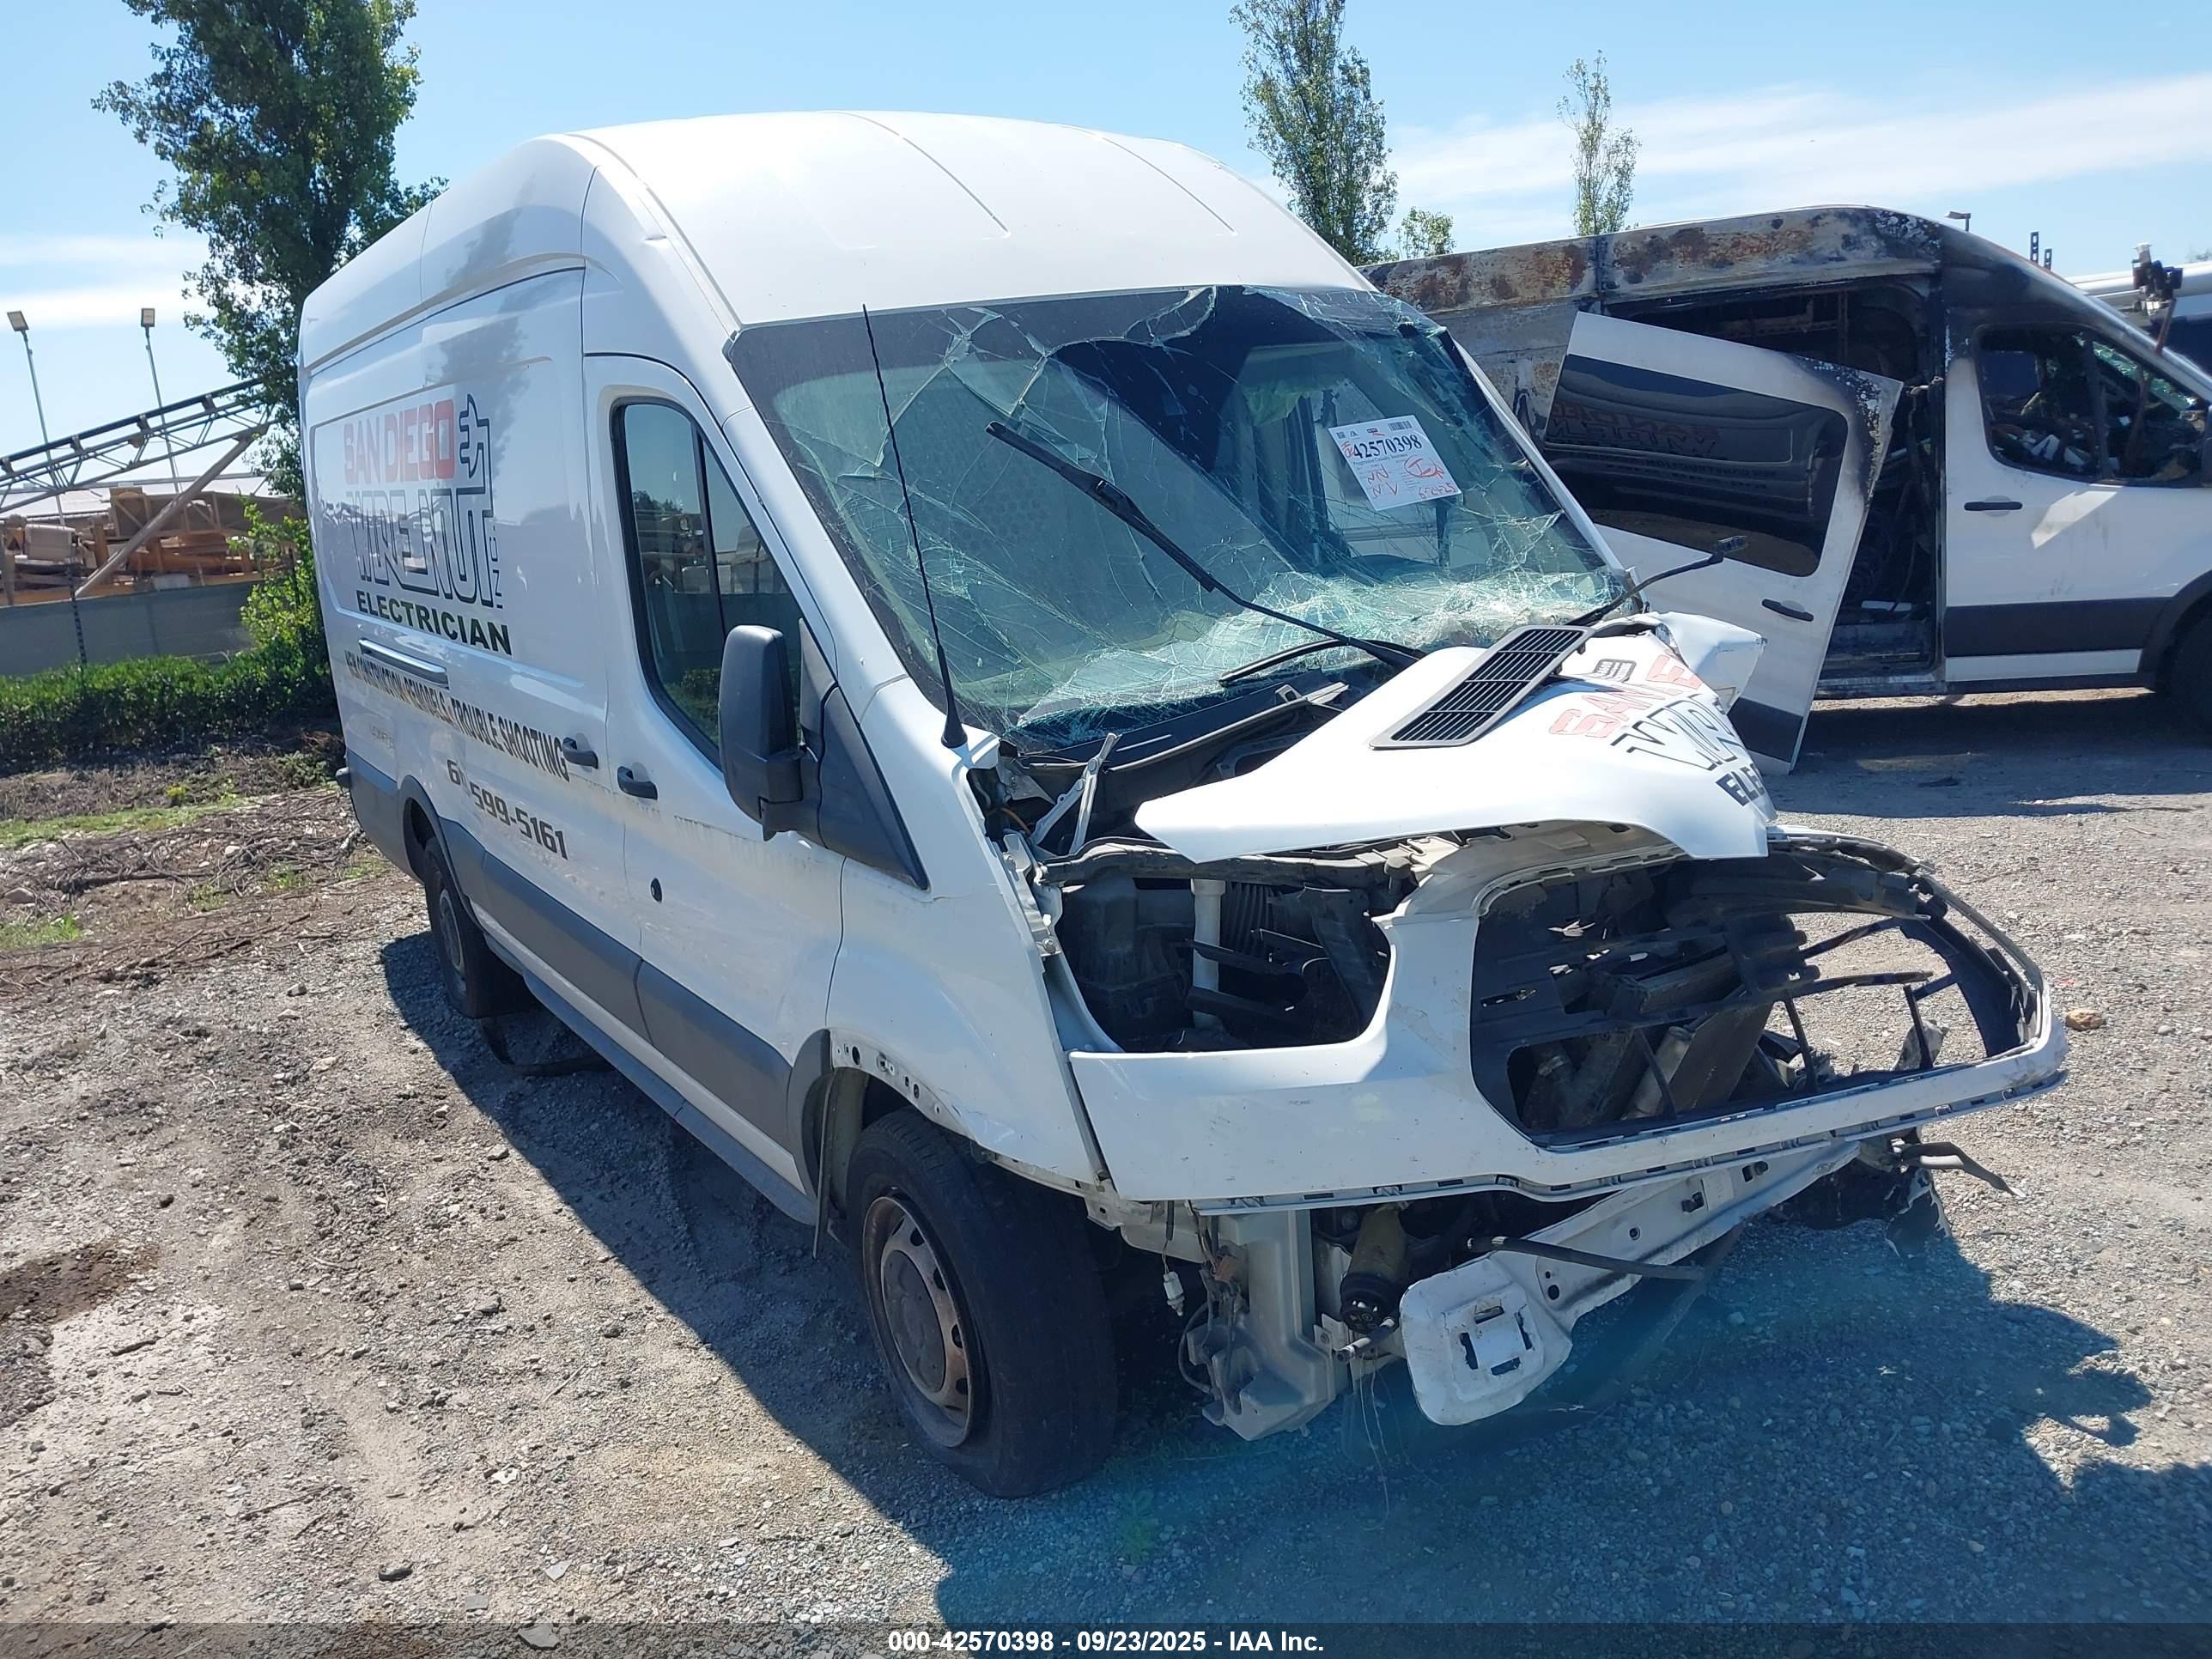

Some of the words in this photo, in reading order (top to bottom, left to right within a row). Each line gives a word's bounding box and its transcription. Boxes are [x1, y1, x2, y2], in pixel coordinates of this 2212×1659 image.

[343, 413, 380, 484] SAN
[385, 399, 455, 482] DIEGO
[1353, 434, 1422, 459] 42570398
[356, 590, 513, 655] ELECTRICIAN
